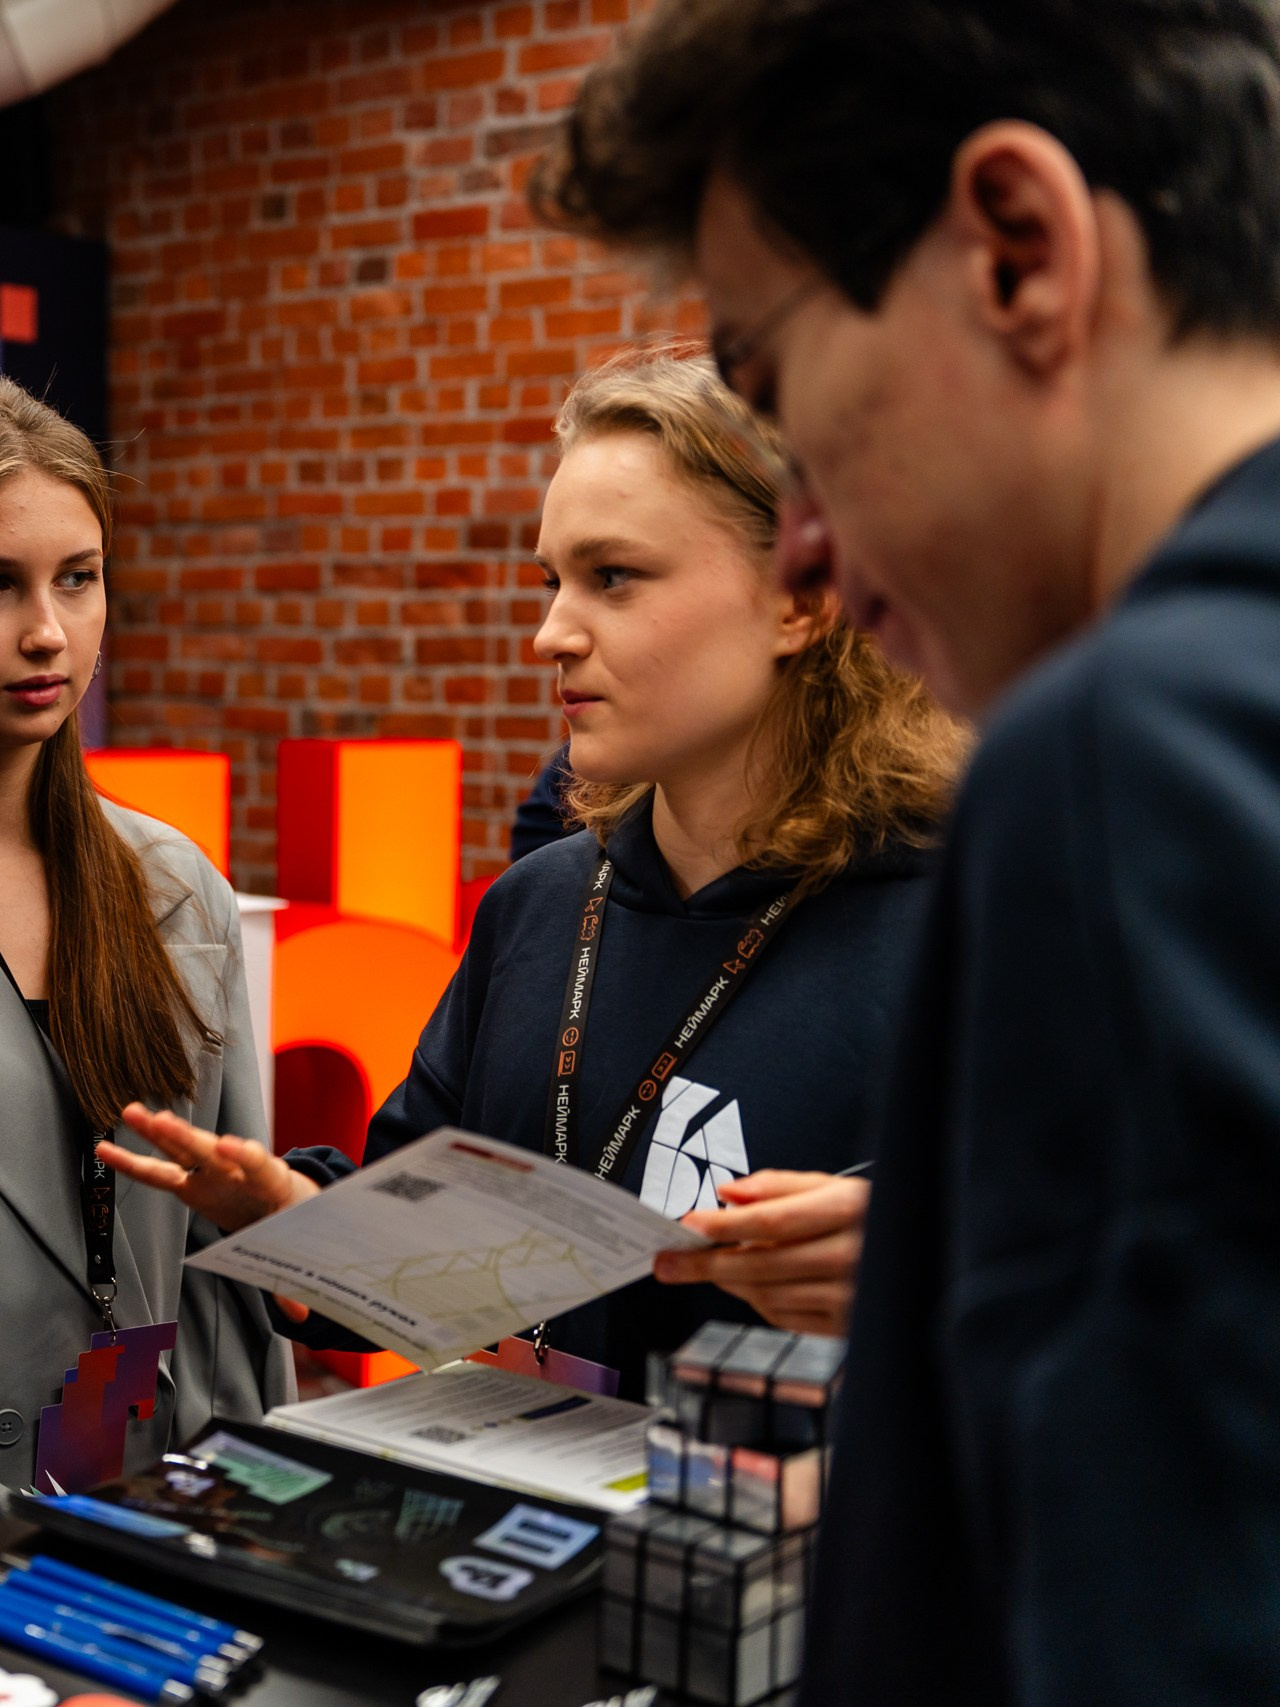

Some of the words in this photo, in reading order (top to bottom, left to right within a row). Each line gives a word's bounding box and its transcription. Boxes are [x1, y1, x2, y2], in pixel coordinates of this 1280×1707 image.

[569, 947, 591, 1020] НЕЙМАРК
[674, 976, 730, 1048] НЕЙМАРК
[555, 1085, 570, 1163] НЕЙМАРК
[594, 1105, 641, 1180] НЕЙМАРК
